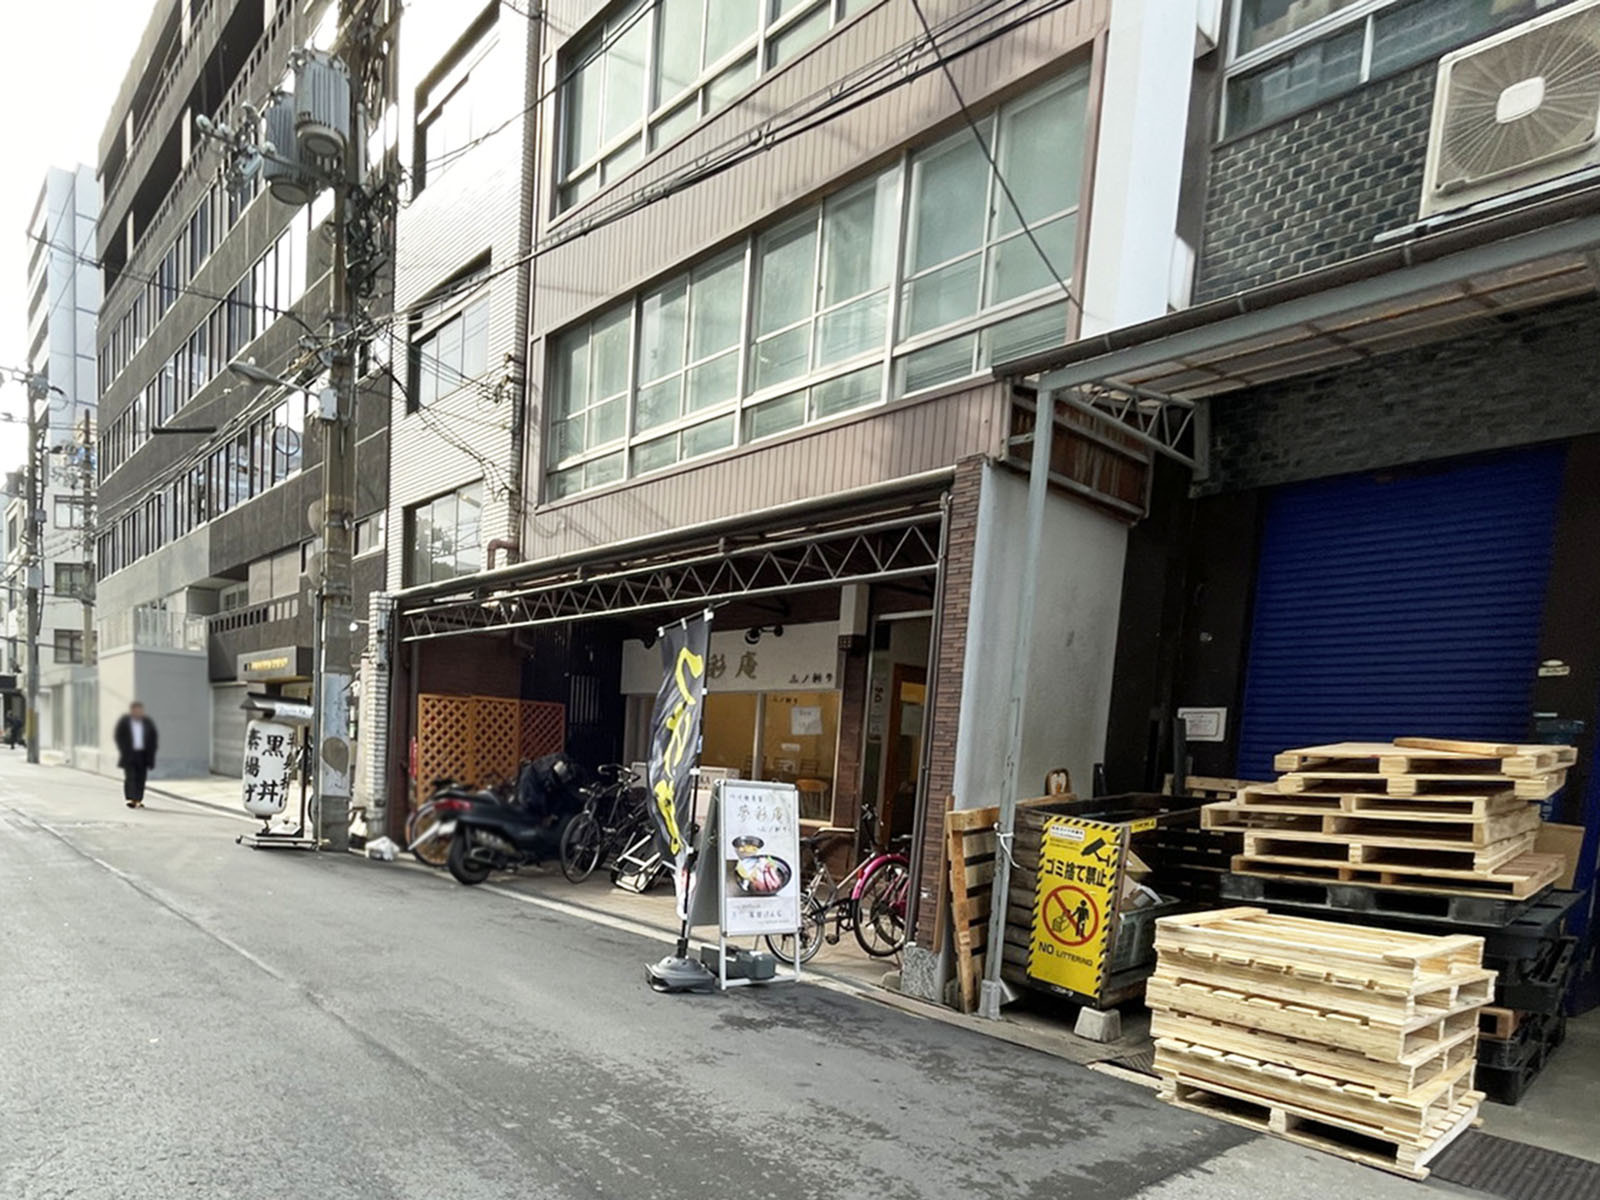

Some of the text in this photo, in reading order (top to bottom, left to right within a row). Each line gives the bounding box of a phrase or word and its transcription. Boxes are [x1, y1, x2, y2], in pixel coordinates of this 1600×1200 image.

[1044, 857, 1108, 888] ゴミ捨て禁止
[1038, 942, 1093, 967] NO LITTERING
